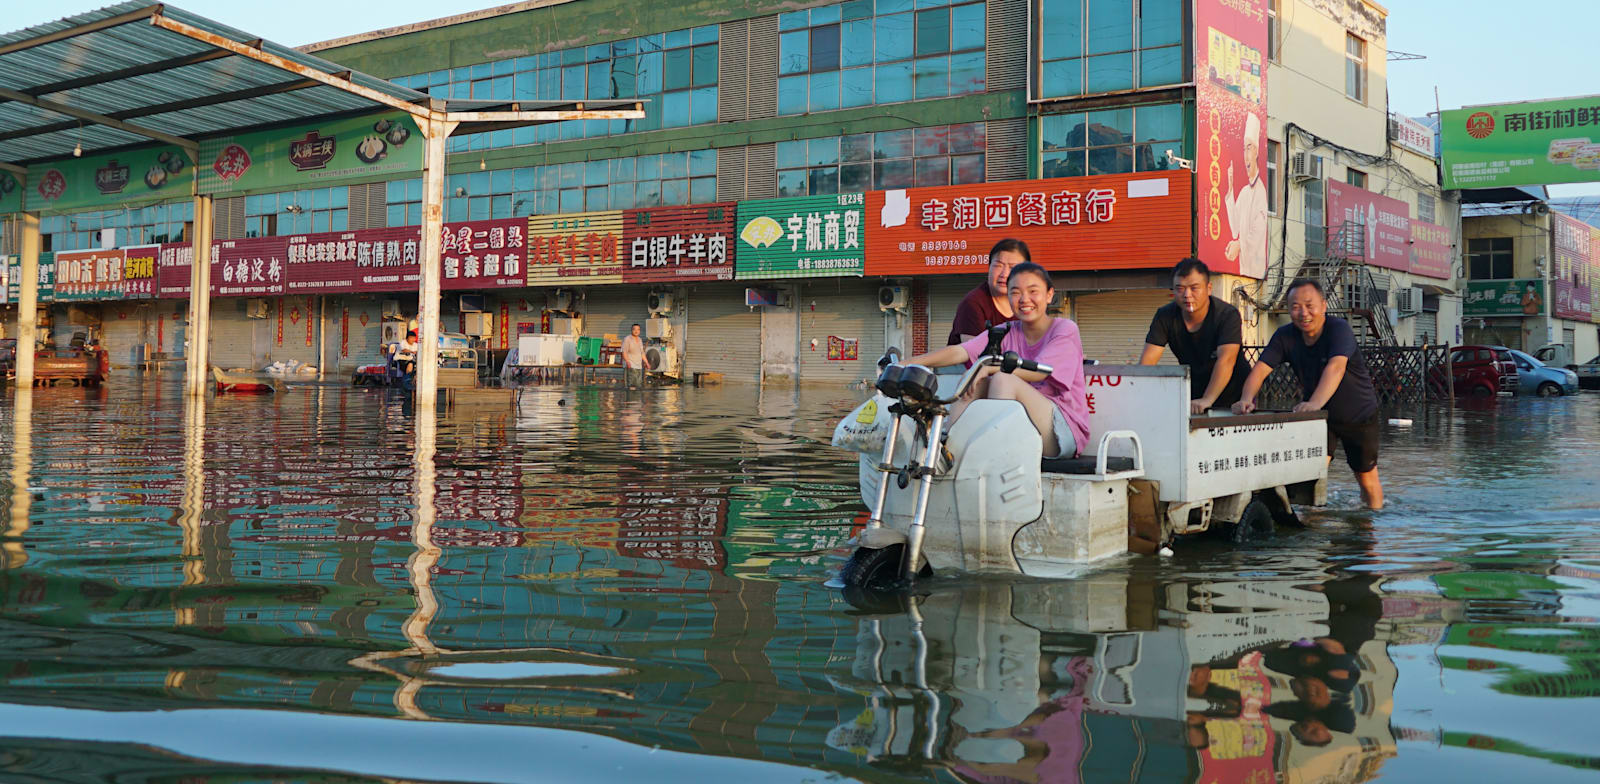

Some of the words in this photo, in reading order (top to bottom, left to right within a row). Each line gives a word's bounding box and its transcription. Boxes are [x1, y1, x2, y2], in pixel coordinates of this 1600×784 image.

[1503, 106, 1600, 132] 南街村鲜
[293, 140, 332, 159] 火锅三侠
[837, 193, 863, 205] 1区23号
[921, 189, 1116, 231] 丰润西餐商行
[441, 226, 523, 254] 红星二锅头
[787, 210, 859, 252] 宇航商贸
[357, 239, 421, 267] 陈倩熟肉
[632, 232, 726, 267] 白银牛羊肉
[898, 242, 915, 252] 电话
[921, 240, 967, 251] 3359168
[223, 256, 282, 283] 白糖淀粉
[445, 253, 519, 278] 智森超市
[925, 255, 989, 266] 1337375915
